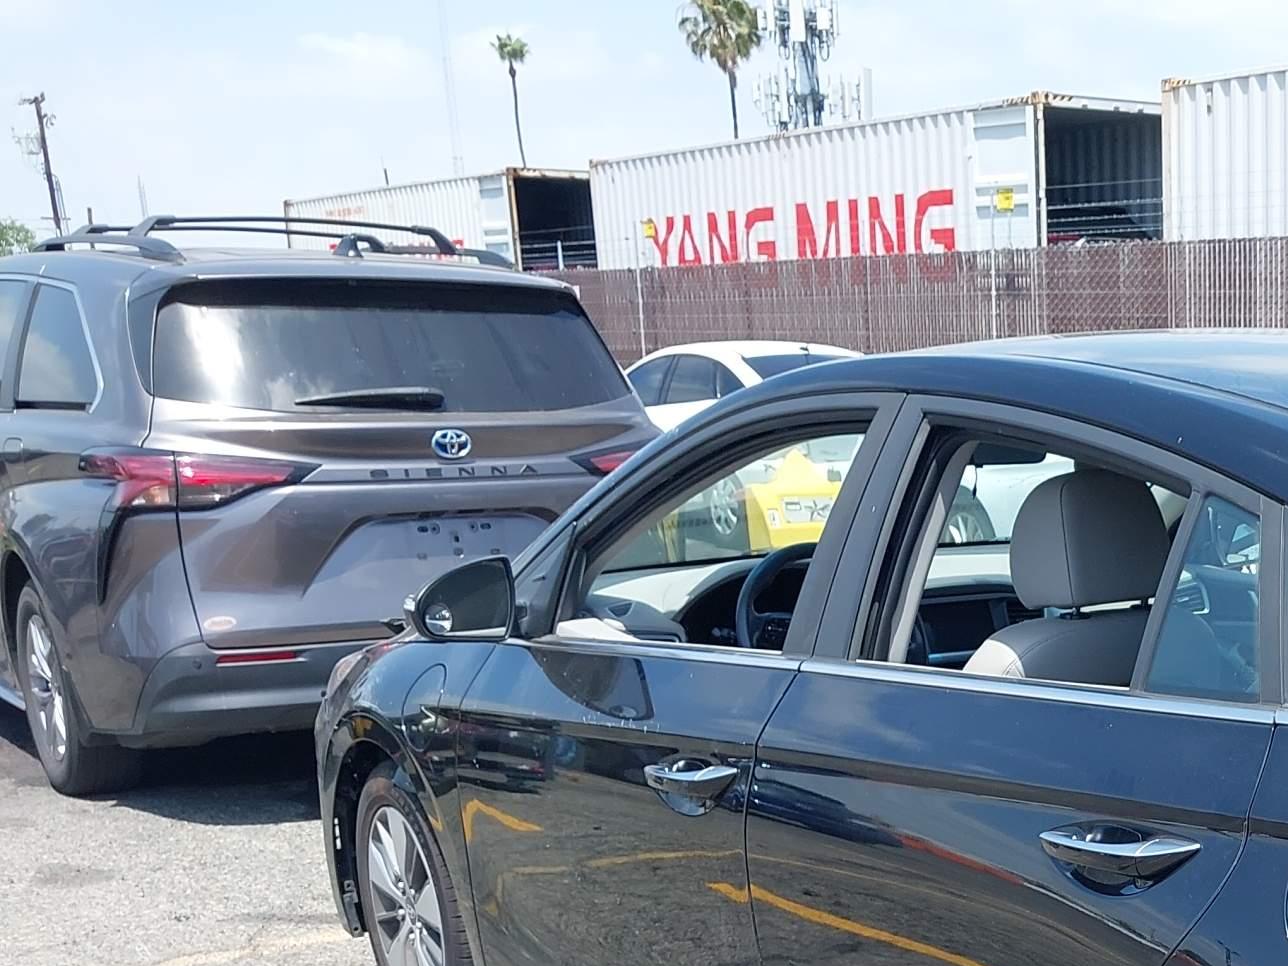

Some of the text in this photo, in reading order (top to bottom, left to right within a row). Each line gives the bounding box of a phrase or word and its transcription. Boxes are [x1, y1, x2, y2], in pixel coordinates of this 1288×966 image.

[651, 190, 957, 267] YANG MING
[369, 463, 538, 479] SIENNA
